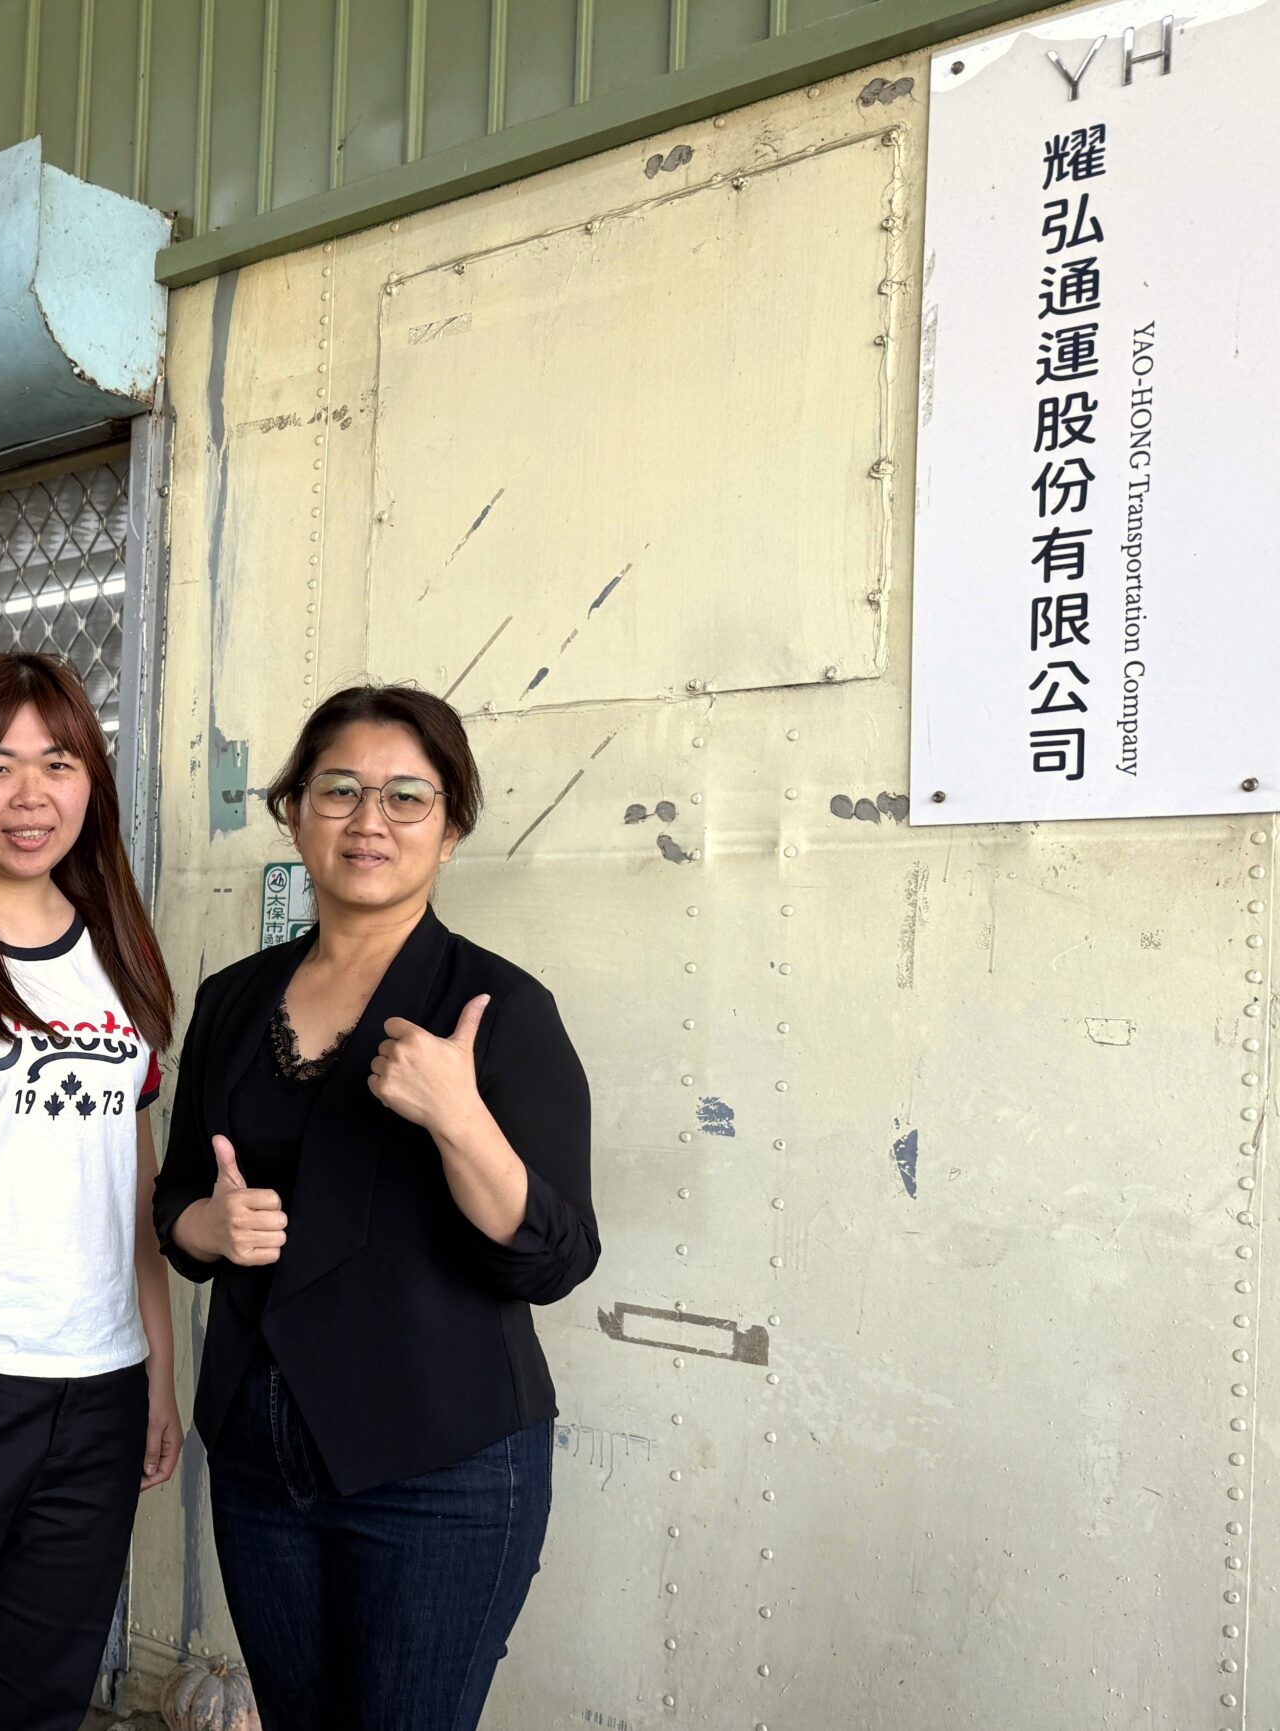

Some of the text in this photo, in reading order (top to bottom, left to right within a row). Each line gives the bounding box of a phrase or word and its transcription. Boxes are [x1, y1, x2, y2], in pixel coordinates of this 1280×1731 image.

[1046, 15, 1173, 101] YH
[1028, 123, 1107, 781] 耀弘通運股份有限公司
[1115, 320, 1156, 777] YAO-HONG Transportation Company
[15, 1089, 125, 1116] 19 73
